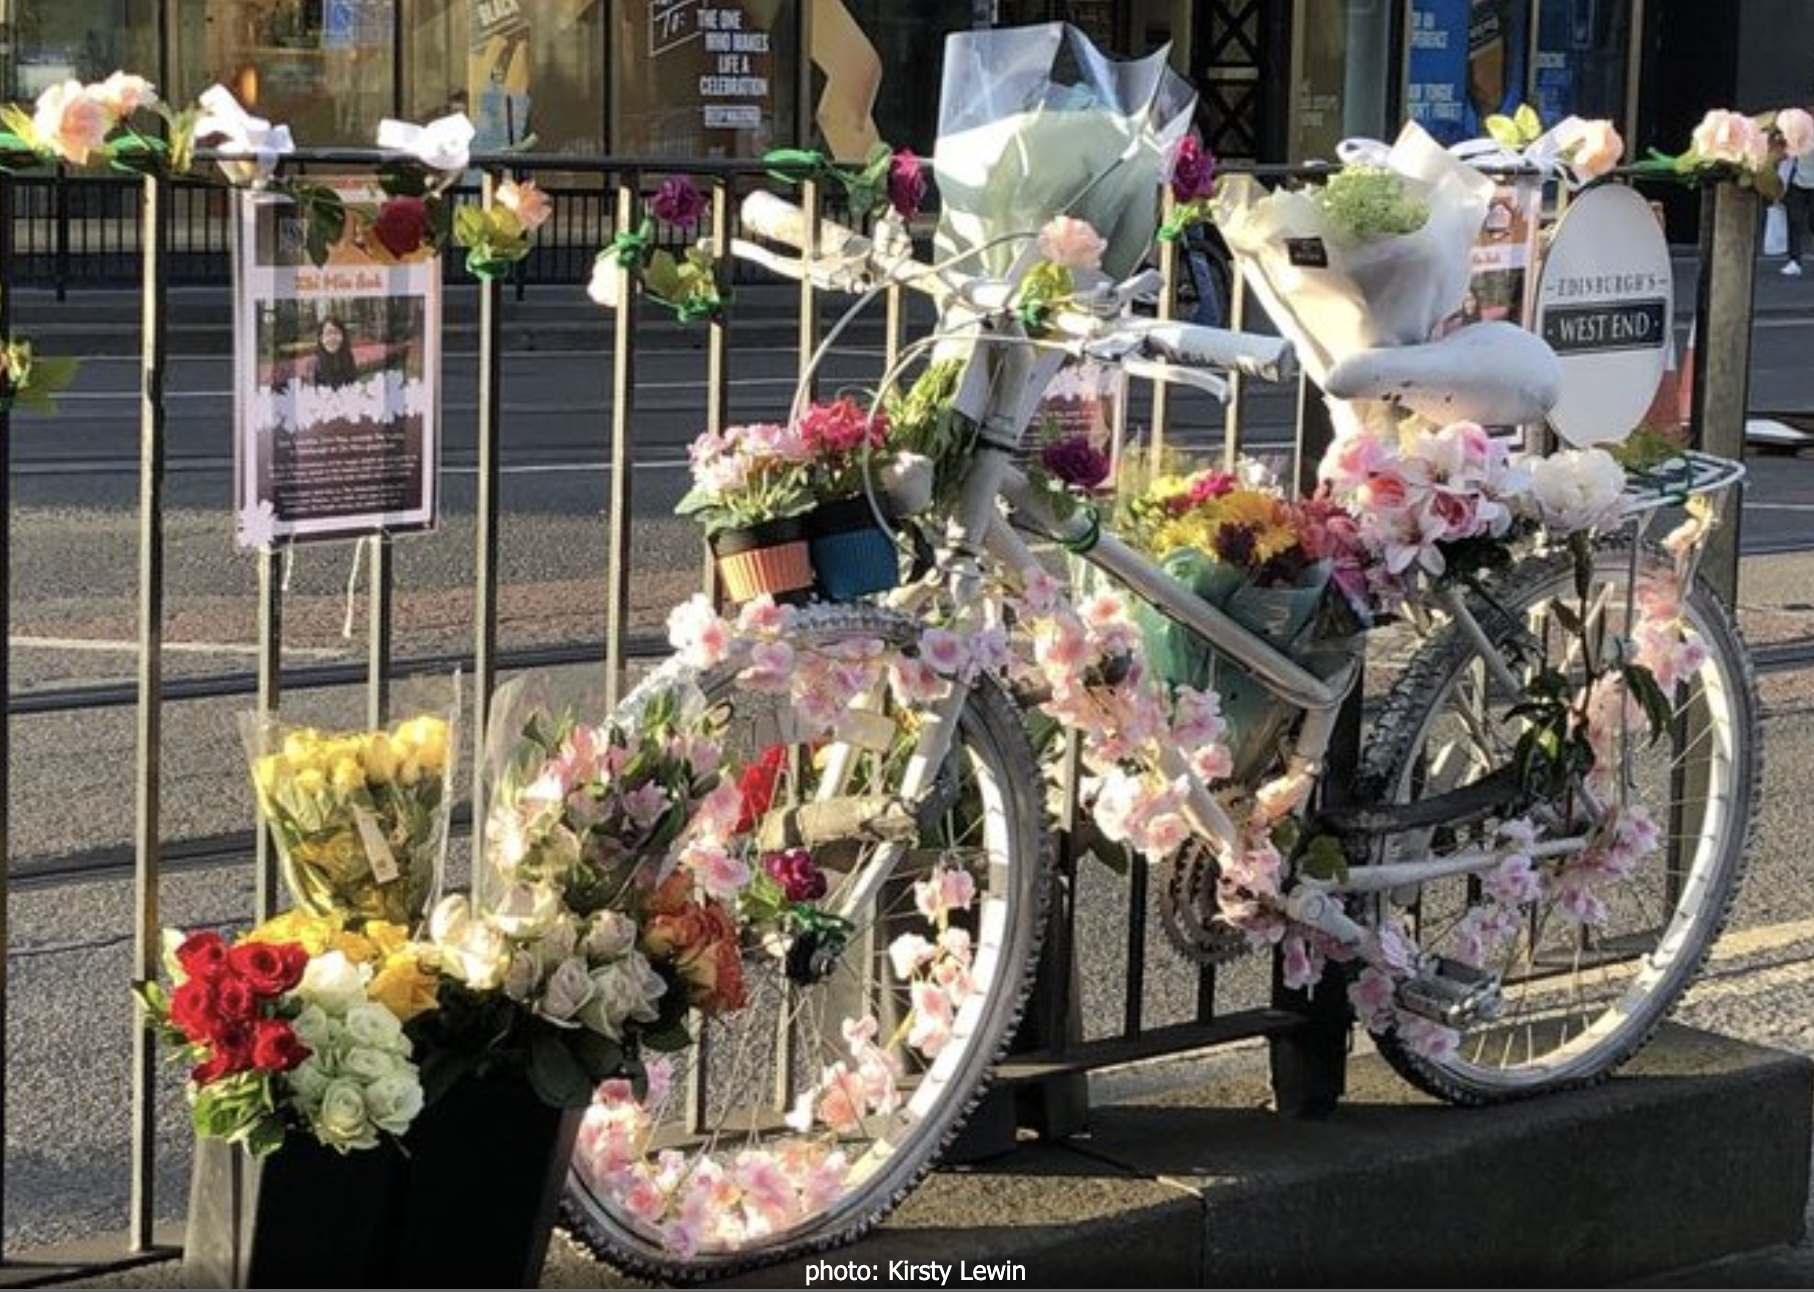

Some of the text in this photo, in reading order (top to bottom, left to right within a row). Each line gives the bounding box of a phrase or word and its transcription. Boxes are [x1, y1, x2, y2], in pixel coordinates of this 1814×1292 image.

[718, 54, 750, 74] LIFE A
[1558, 273, 1657, 297] EDINBURGH'S
[1560, 311, 1651, 342] WEST END
